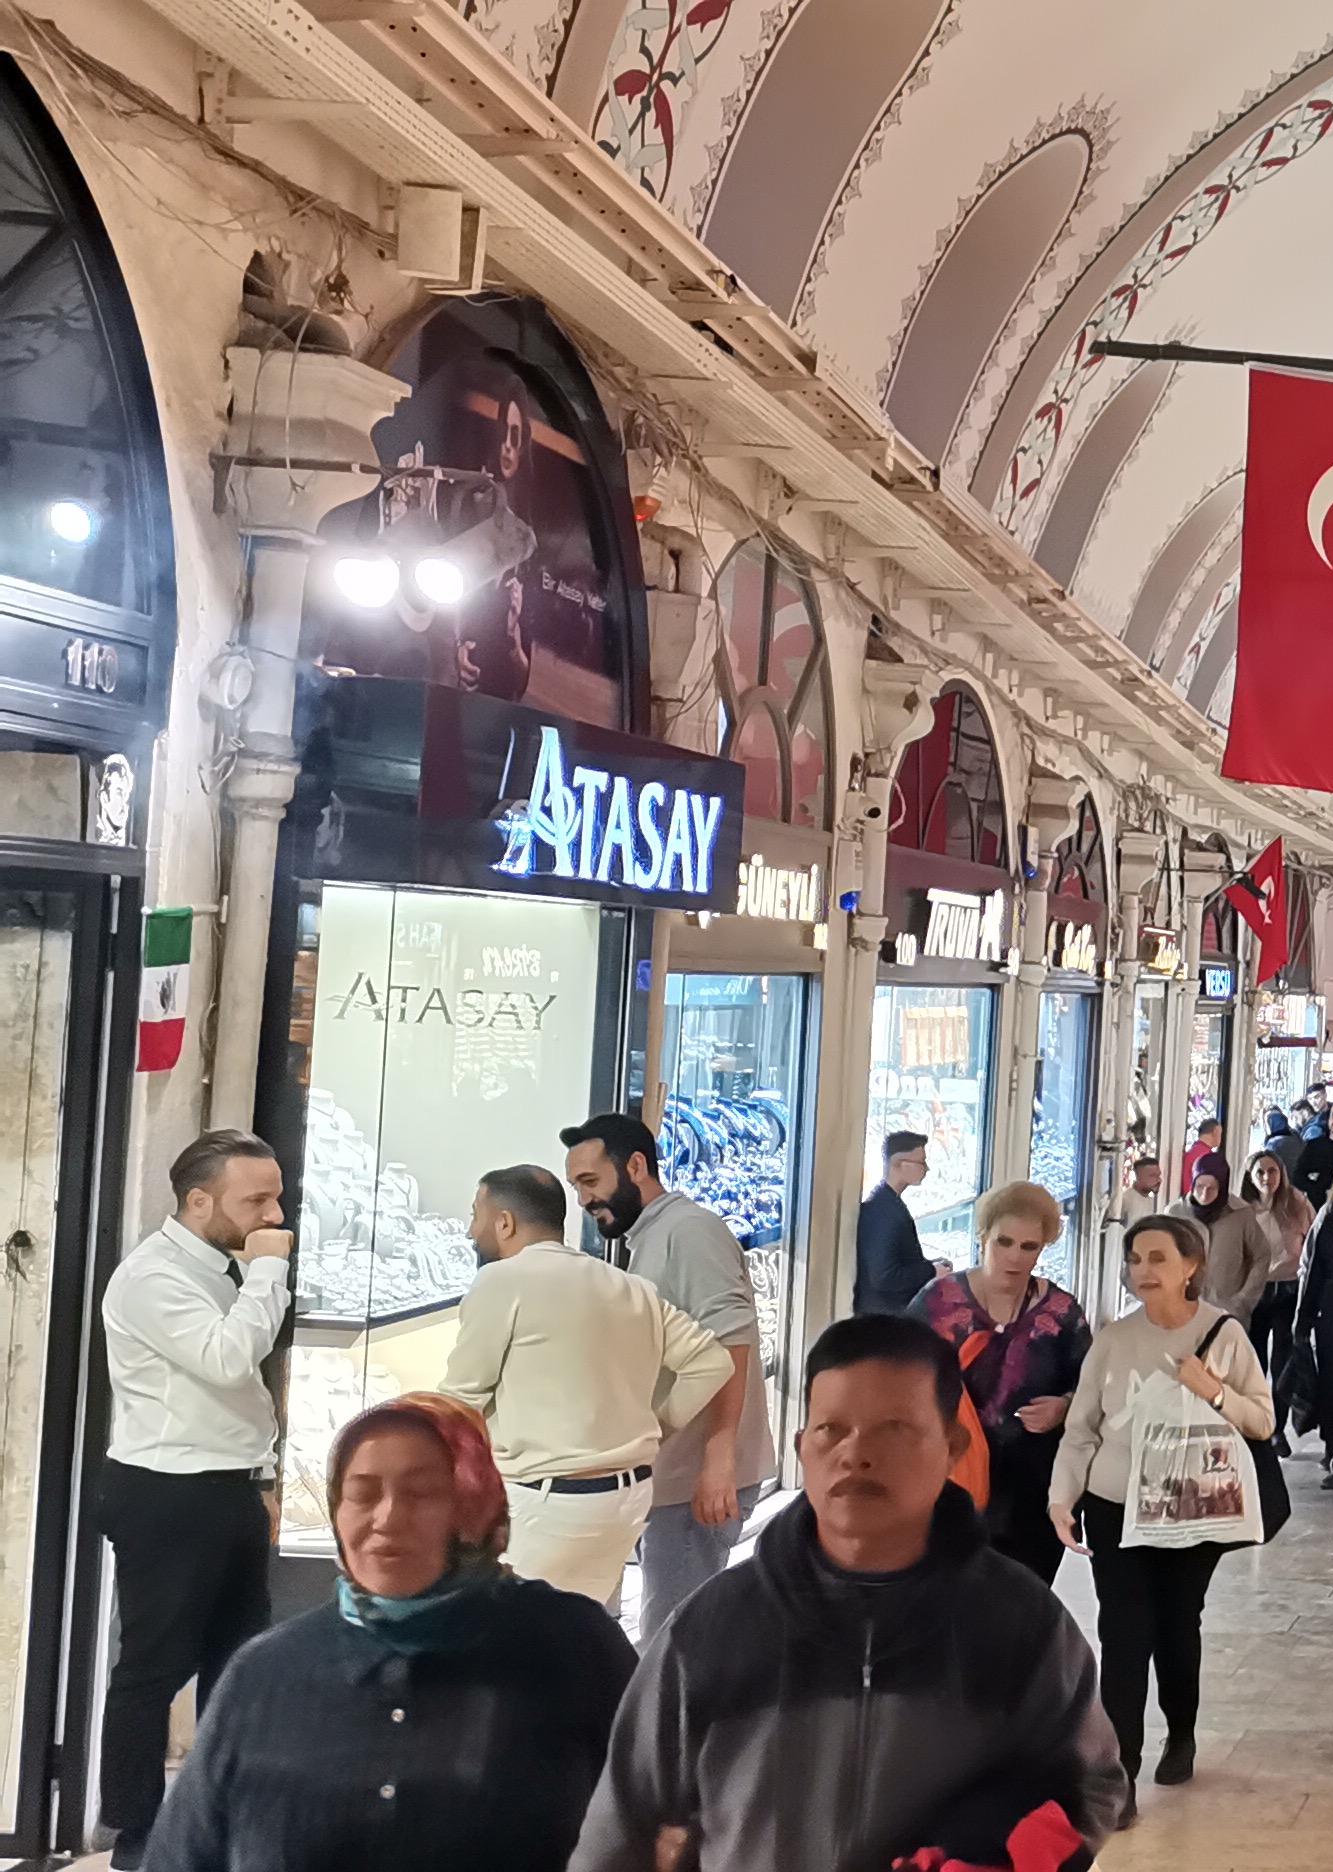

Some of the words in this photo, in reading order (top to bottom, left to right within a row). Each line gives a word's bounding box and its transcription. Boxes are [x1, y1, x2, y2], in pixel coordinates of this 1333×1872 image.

[65, 637, 119, 694] 110
[497, 725, 724, 894] ATASAY
[326, 971, 558, 1031] ATASAY
